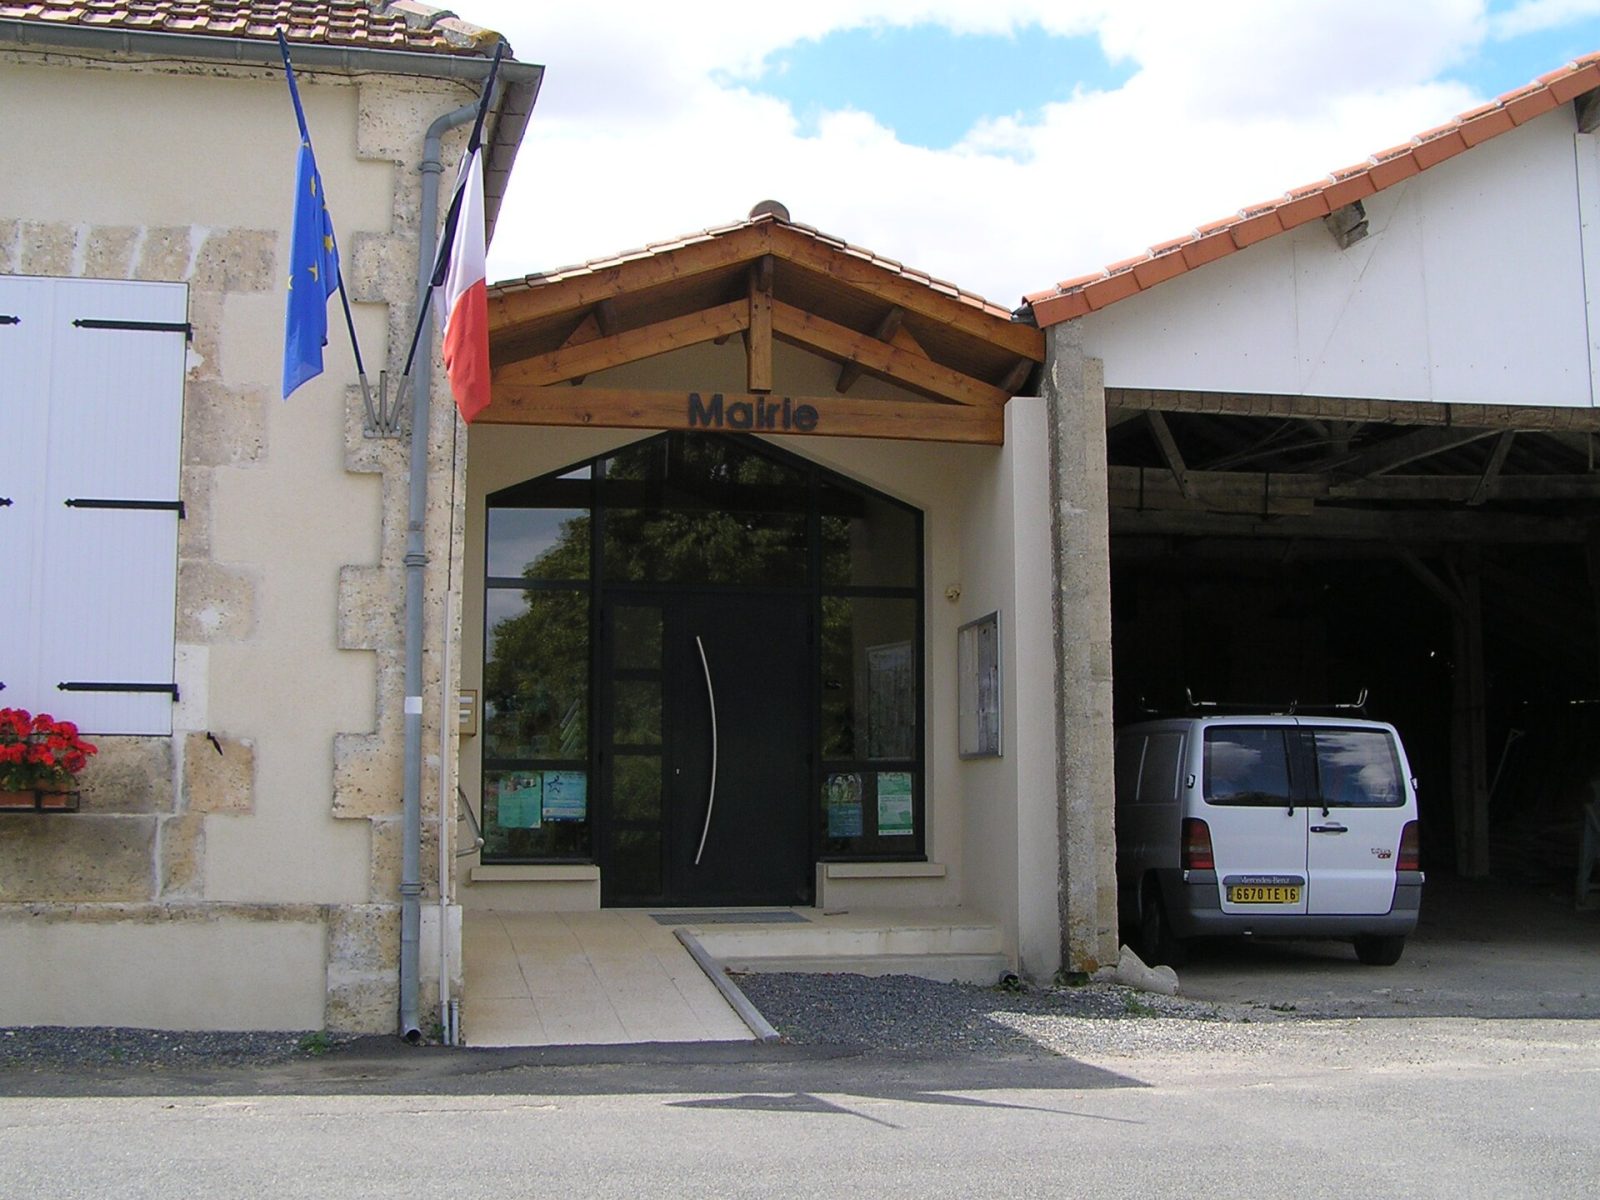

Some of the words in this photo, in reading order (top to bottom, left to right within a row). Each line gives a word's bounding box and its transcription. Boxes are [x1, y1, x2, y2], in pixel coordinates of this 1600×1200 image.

[689, 392, 819, 432] Mairie
[1236, 887, 1264, 900] 6670
[1266, 887, 1281, 900] TE
[1284, 887, 1296, 900] 16
